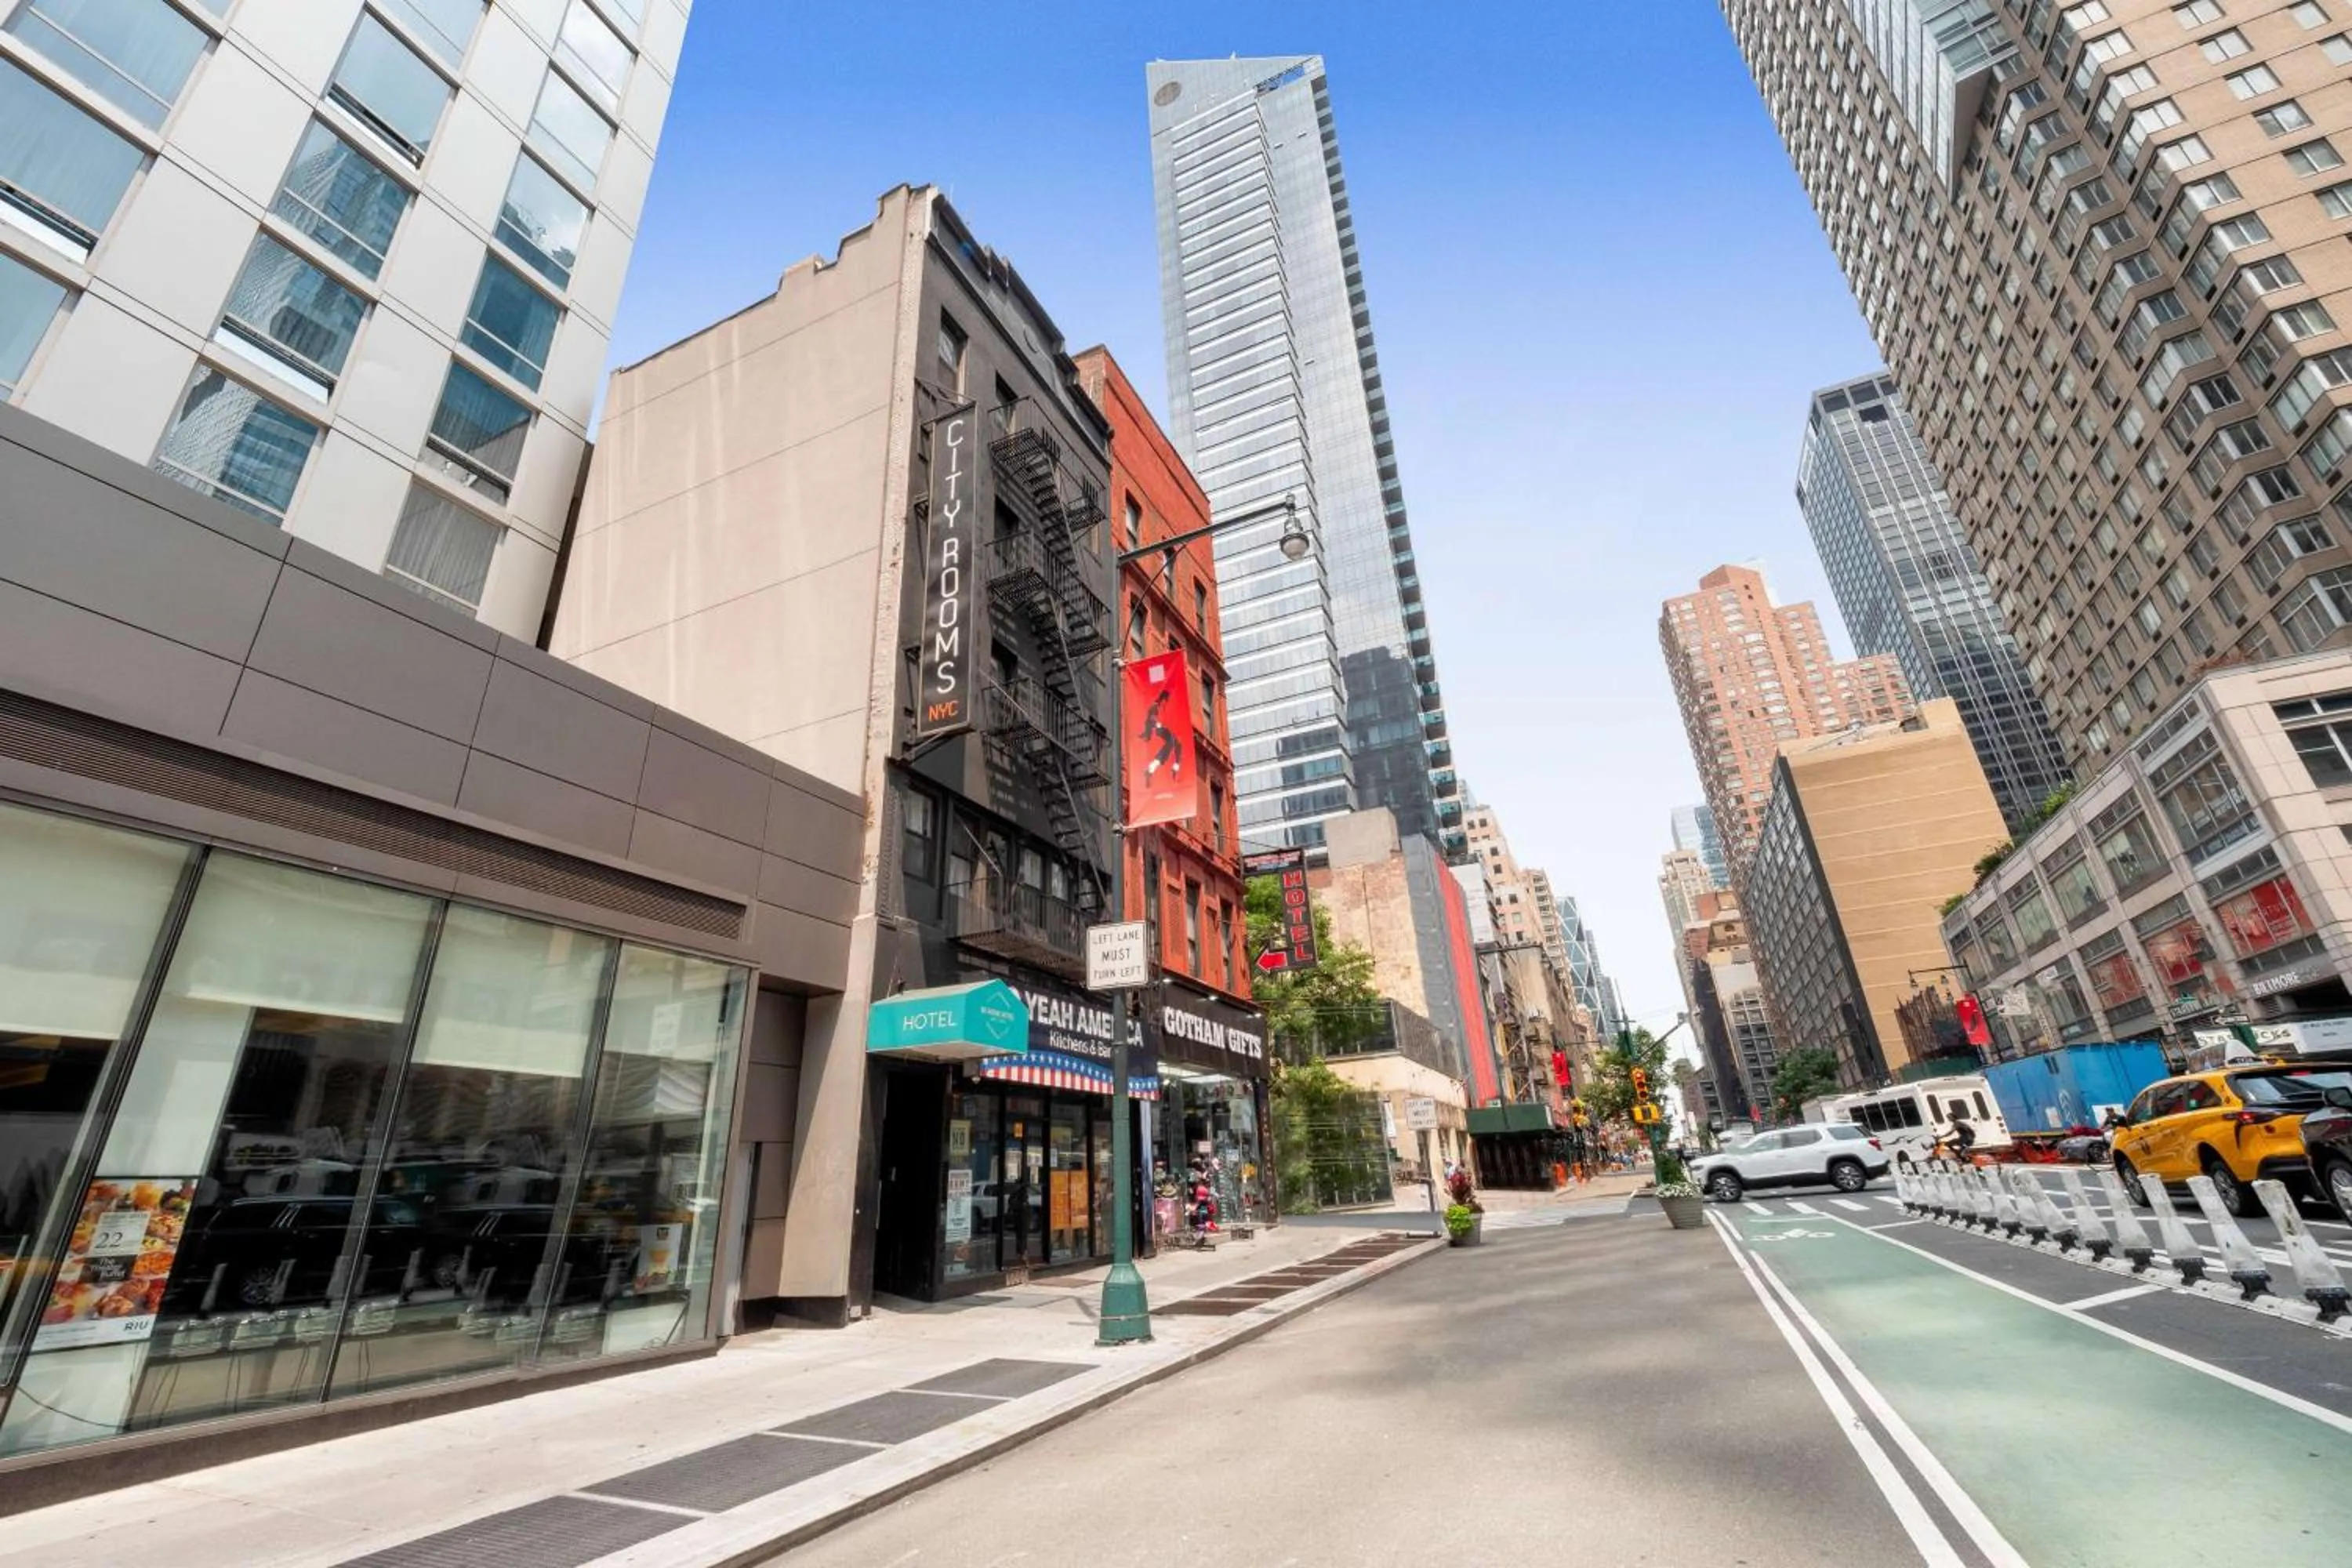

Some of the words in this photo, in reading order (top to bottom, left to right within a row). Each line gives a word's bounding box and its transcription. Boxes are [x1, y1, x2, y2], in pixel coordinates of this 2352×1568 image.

[943, 419, 964, 528] CITY
[935, 538, 960, 695] ROOMS
[928, 700, 959, 722] NYC
[1117, 929, 1140, 942] LANE
[1102, 947, 1131, 962] MUST
[1094, 968, 1116, 979] TURN
[1120, 965, 1142, 977] LEFT
[902, 1011, 958, 1030] HOTEL
[1025, 990, 1073, 1031] YEAH
[1076, 1006, 1144, 1047] AMECA
[1050, 1029, 1088, 1054] Kitchens
[1090, 1040, 1097, 1054] &
[1164, 1006, 1225, 1049] GOTHAM
[1229, 1028, 1262, 1060] GIFTS
[2197, 1028, 2292, 1046] STACKS
[95, 1231, 123, 1249] 22
[124, 1320, 149, 1331] RIU
